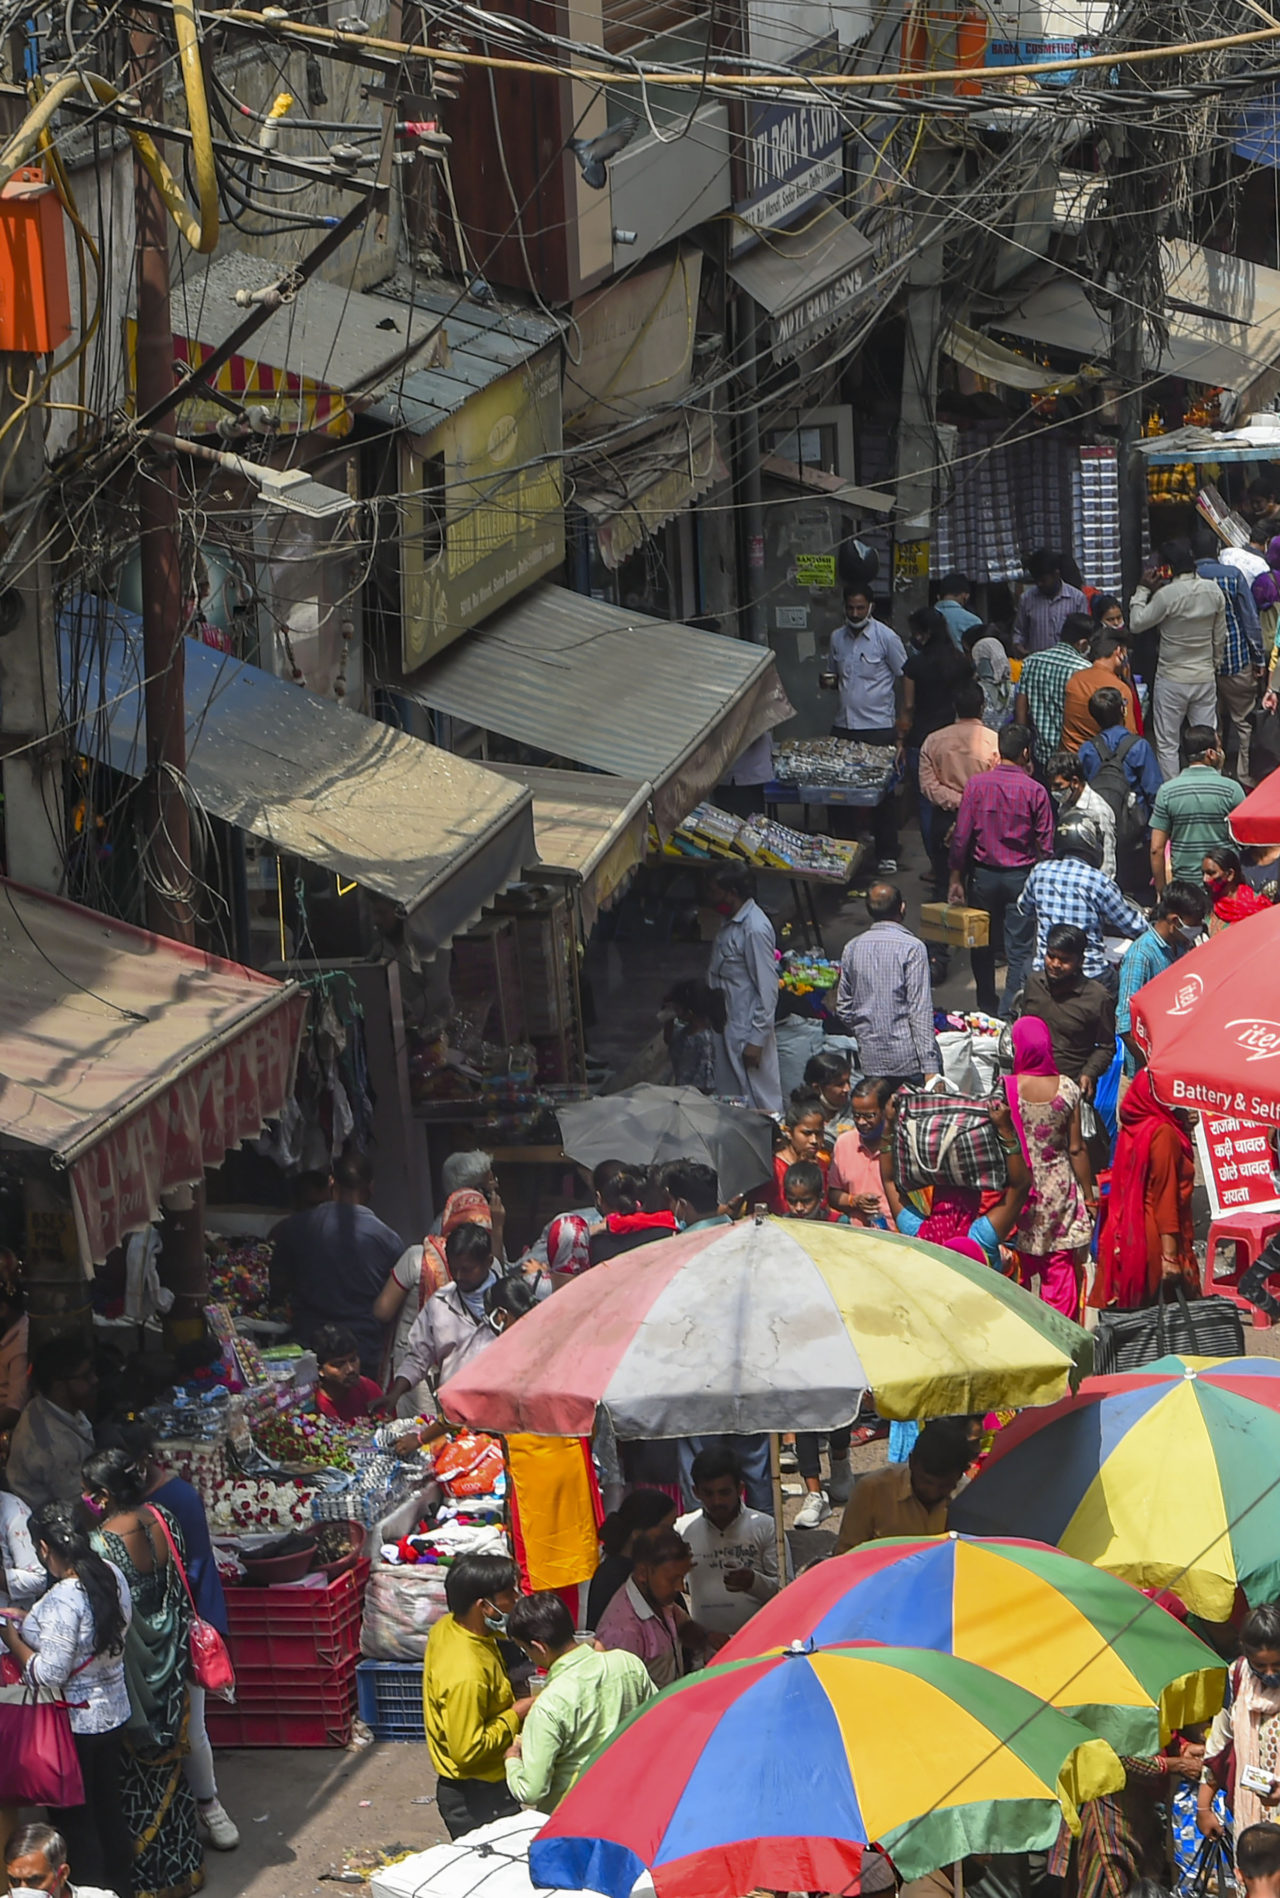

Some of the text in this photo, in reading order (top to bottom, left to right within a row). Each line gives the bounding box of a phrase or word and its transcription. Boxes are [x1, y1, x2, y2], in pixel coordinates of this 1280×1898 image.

[772, 111, 797, 179] RAM
[800, 107, 808, 157] &
[1173, 1079, 1233, 1111] Battery
[1233, 1092, 1247, 1111] &
[1234, 1136, 1266, 1153] चावल
[1239, 1160, 1271, 1177] चावल
[1222, 1187, 1250, 1204] रायता
